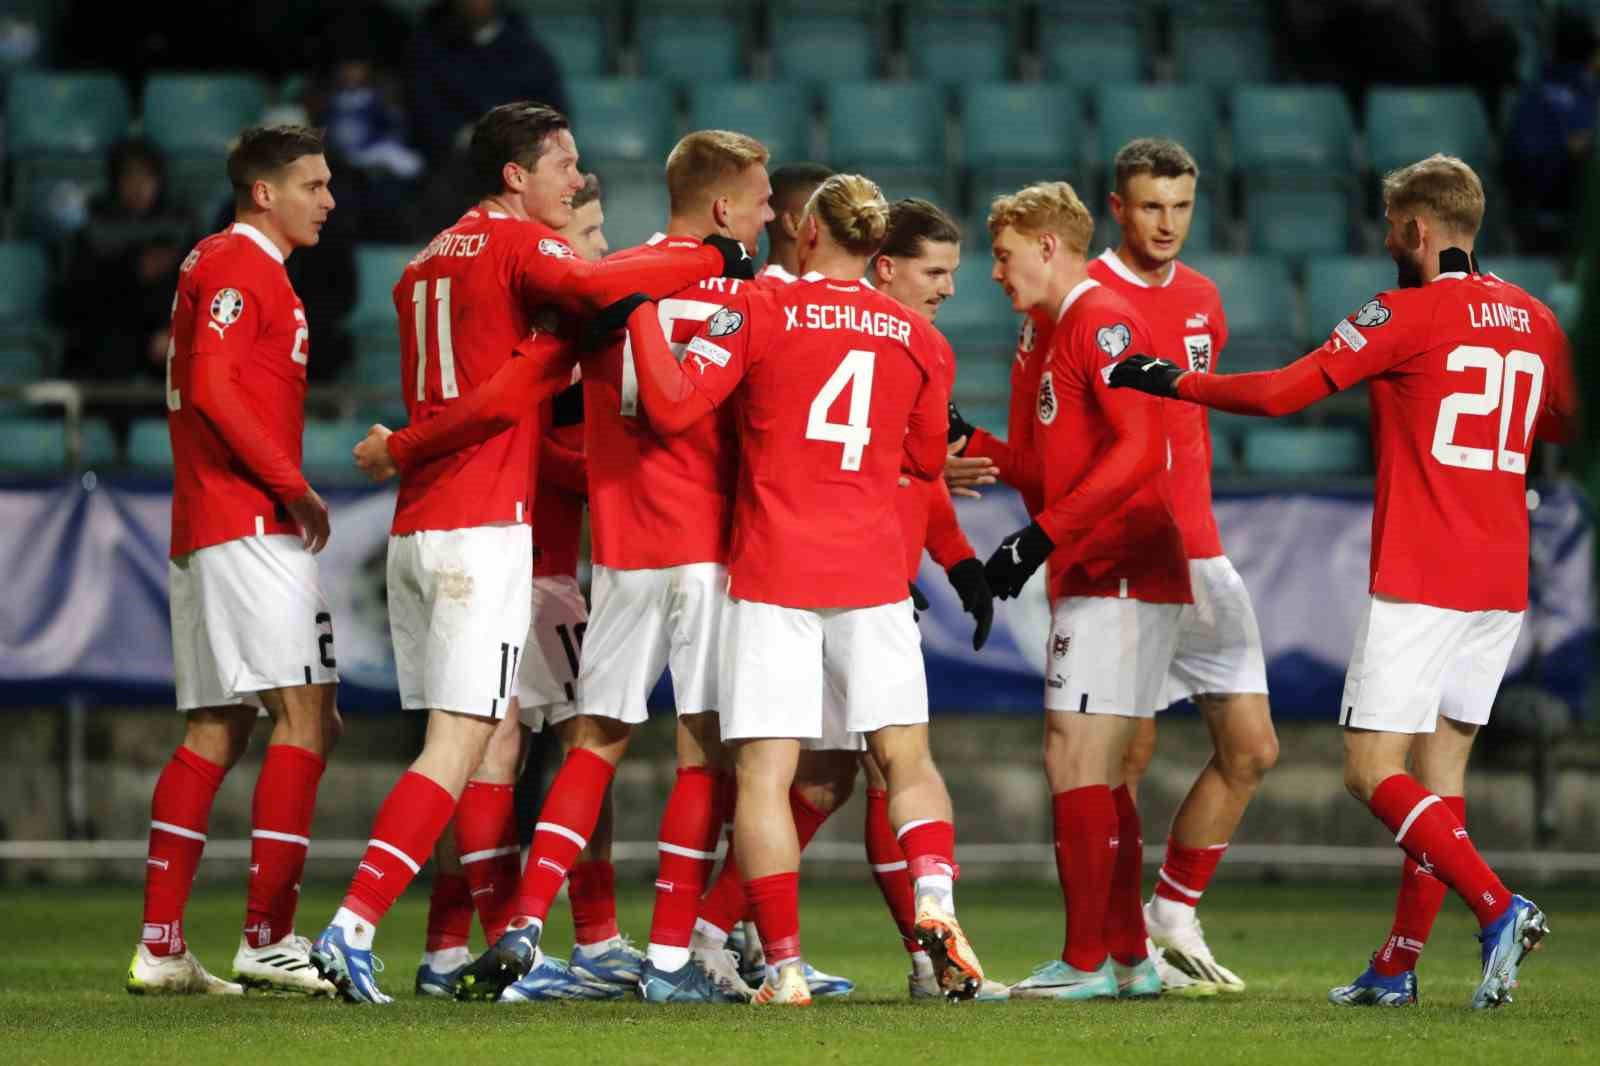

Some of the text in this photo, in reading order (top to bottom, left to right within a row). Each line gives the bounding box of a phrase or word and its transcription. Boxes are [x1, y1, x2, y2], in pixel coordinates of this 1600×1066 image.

[408, 233, 489, 264] RITSCH
[412, 277, 460, 401] 11
[784, 304, 911, 346] X.SCHLAGER
[1468, 303, 1531, 333] LAIMER
[805, 349, 876, 471] 4
[1431, 345, 1545, 475] 20
[315, 612, 336, 668] 2
